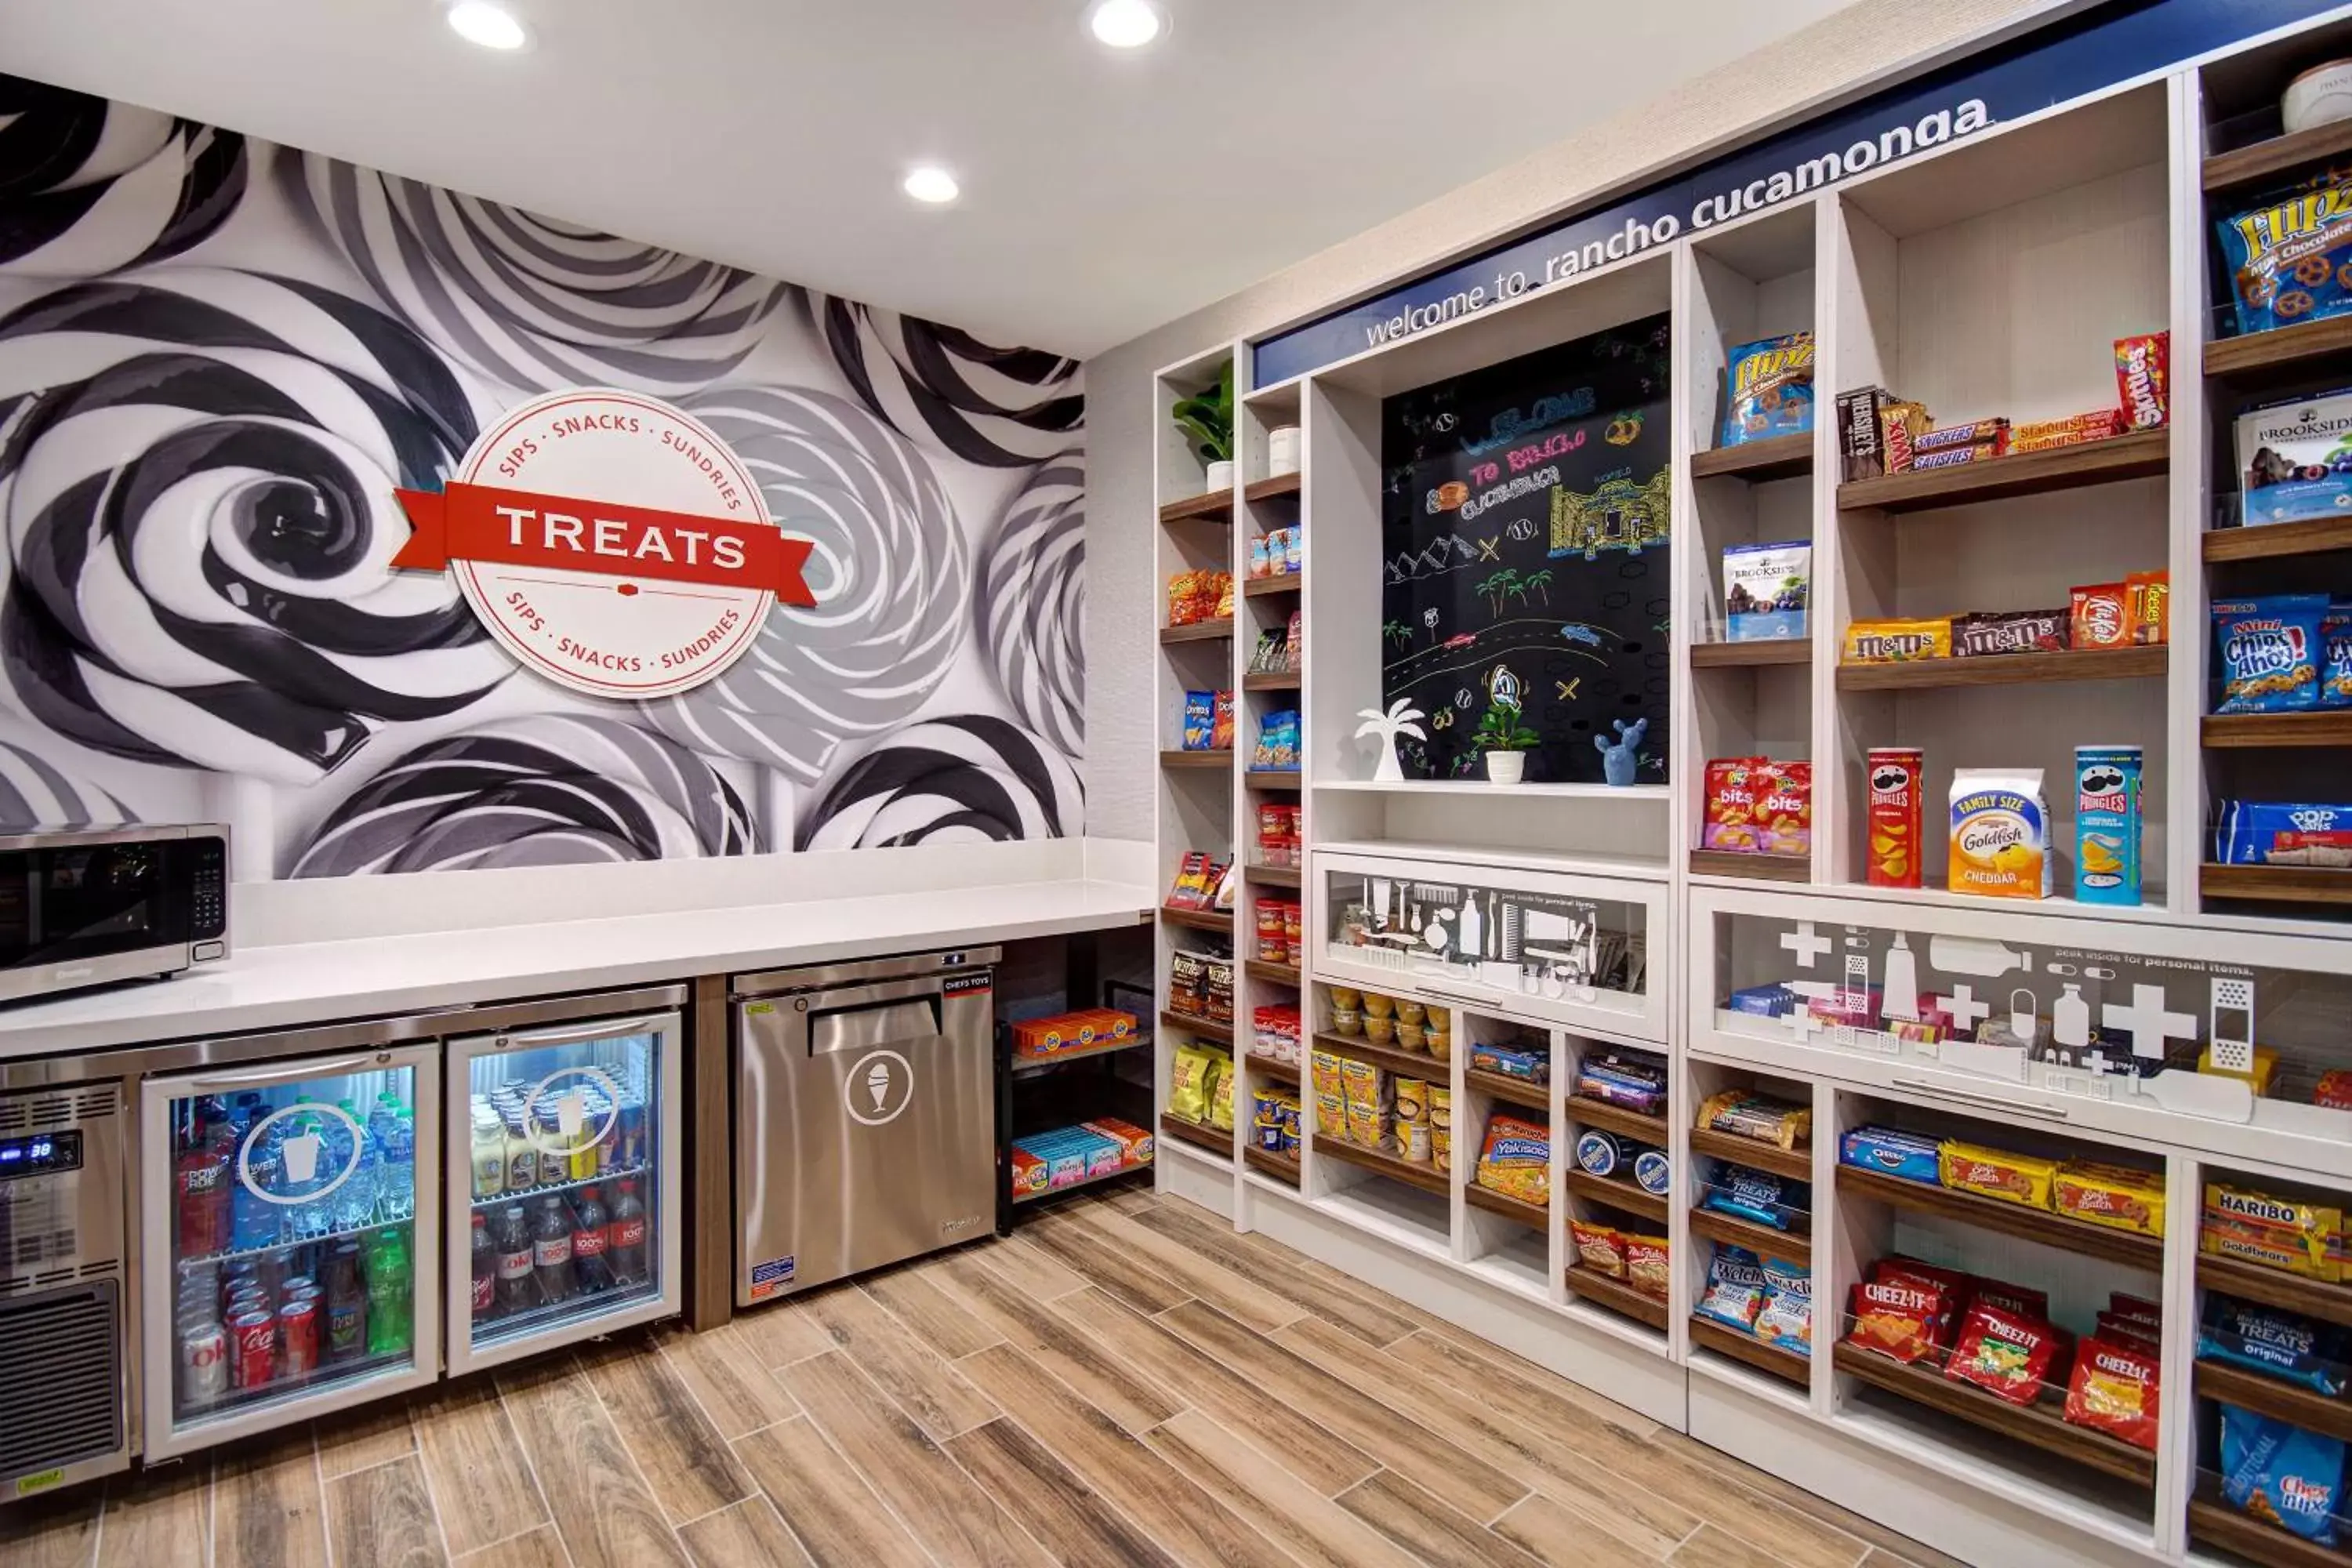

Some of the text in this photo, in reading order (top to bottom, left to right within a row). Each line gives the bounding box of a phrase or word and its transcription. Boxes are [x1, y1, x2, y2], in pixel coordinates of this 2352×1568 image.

[1366, 284, 1485, 348] welcome
[1494, 267, 1526, 299] to
[1545, 212, 1680, 284] rancho
[1915, 424, 1975, 452] SNICKERS
[499, 413, 742, 512] SIPS SNACKS SUNDRIES
[1470, 463, 1498, 487] TO
[495, 504, 746, 571] TREATS
[505, 590, 741, 673] SIPS SNACKS SUNDRIES
[1720, 788, 1754, 804] bits
[1768, 795, 1803, 811] bits
[1871, 791, 1908, 808] PRINGLES
[1957, 795, 2027, 815] FAMILY SIZE
[2080, 793, 2125, 813] PRINGLES
[1963, 829, 2024, 852] Goldfish
[1963, 870, 2018, 886] CHEDDAR
[2054, 949, 2084, 960] peek
[2086, 950, 2122, 964] inside
[2124, 953, 2143, 965] for
[2144, 958, 2206, 972] personal
[2220, 1193, 2296, 1223] HARIBO
[2223, 1240, 2289, 1263] Goldbears
[1864, 1283, 1926, 1309] CHEEZ-IT
[1988, 1319, 2041, 1348] CHEEZ-IT
[2237, 1322, 2310, 1355] TREATS
[2095, 1352, 2150, 1380] CHEEZ-IT
[2280, 1474, 2332, 1499] Chex
[2281, 1491, 2329, 1515] mix
